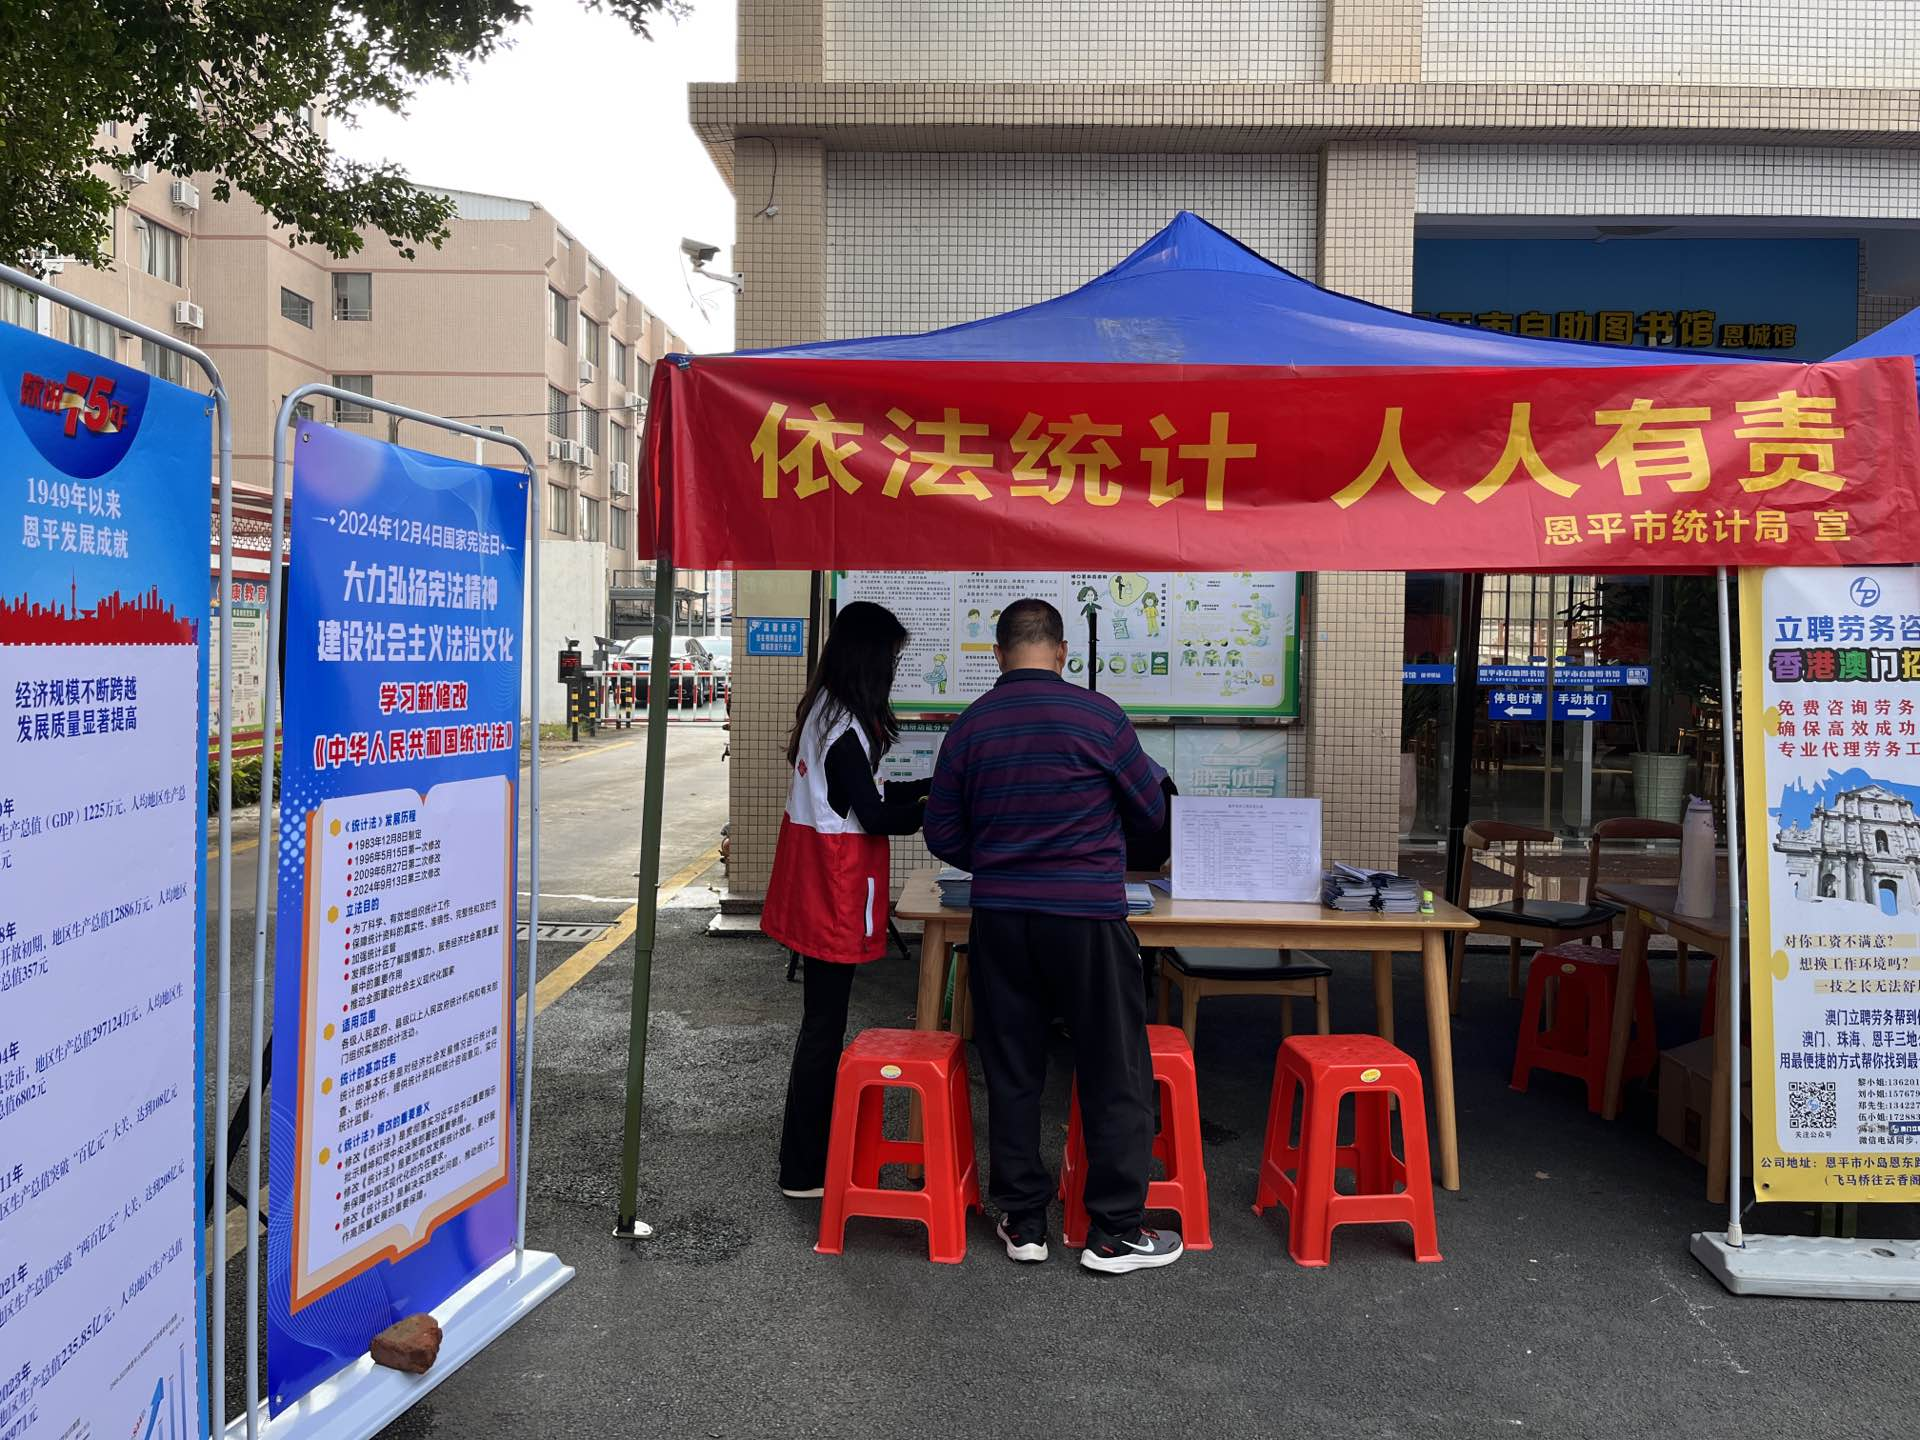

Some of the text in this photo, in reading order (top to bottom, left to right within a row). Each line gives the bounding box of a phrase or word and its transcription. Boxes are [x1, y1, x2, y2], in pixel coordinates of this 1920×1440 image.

[1412, 310, 1716, 347] 市自助图书馆
[1720, 323, 1797, 349] 恩城馆
[751, 390, 1846, 511] 依法统计 人人有责
[27, 477, 122, 519] 1949年以来
[22, 515, 129, 559] 恩平发展成就
[338, 509, 500, 557] 2024年12月4日国家宪法日
[1544, 508, 1851, 548] 恩平市统计局 宣
[217, 581, 268, 605] 康教育
[344, 561, 498, 611] 大力弘扬宪法精神
[318, 619, 513, 663] 建设社会主义法治文化
[1775, 615, 1920, 643] 立聘劳务咨
[1771, 649, 1920, 683] 香港澳门招
[15, 676, 138, 709] 经济规模不断跨越
[379, 682, 468, 715] 学习新修改
[1494, 693, 1542, 705] 停电时请
[1558, 693, 1607, 705] 手动推门
[1778, 700, 1914, 717] 免费咨询劳务
[17, 706, 138, 743] 发展质量显著提高
[1777, 720, 1916, 737] 确保高效成功
[313, 723, 514, 771] 《中华人民共和国统计法》
[1778, 741, 1920, 757] 专业代理劳务工
[344, 808, 416, 836] 《统计法》发展历程
[354, 838, 440, 867] 1996年5月15日第一次修改
[355, 828, 421, 852] 1983年12月8日制定
[354, 852, 440, 882] 2009年6月27日第二次修改
[353, 866, 440, 898] 2024年9月13日第三次修改
[346, 897, 378, 918] 立法目的
[351, 942, 395, 965] 加强统计监督
[0, 955, 48, 991] 总值357元
[350, 969, 402, 995] 展中的重要作用
[1818, 979, 1920, 994] 一技之长无法舒
[342, 1008, 375, 1033] 适用范围
[1802, 1030, 1920, 1048] 澳门、珠海、恩平三地
[340, 1052, 396, 1086] 统计的基本任务
[1779, 1051, 1920, 1070] 用最便捷的方式帮你找到最
